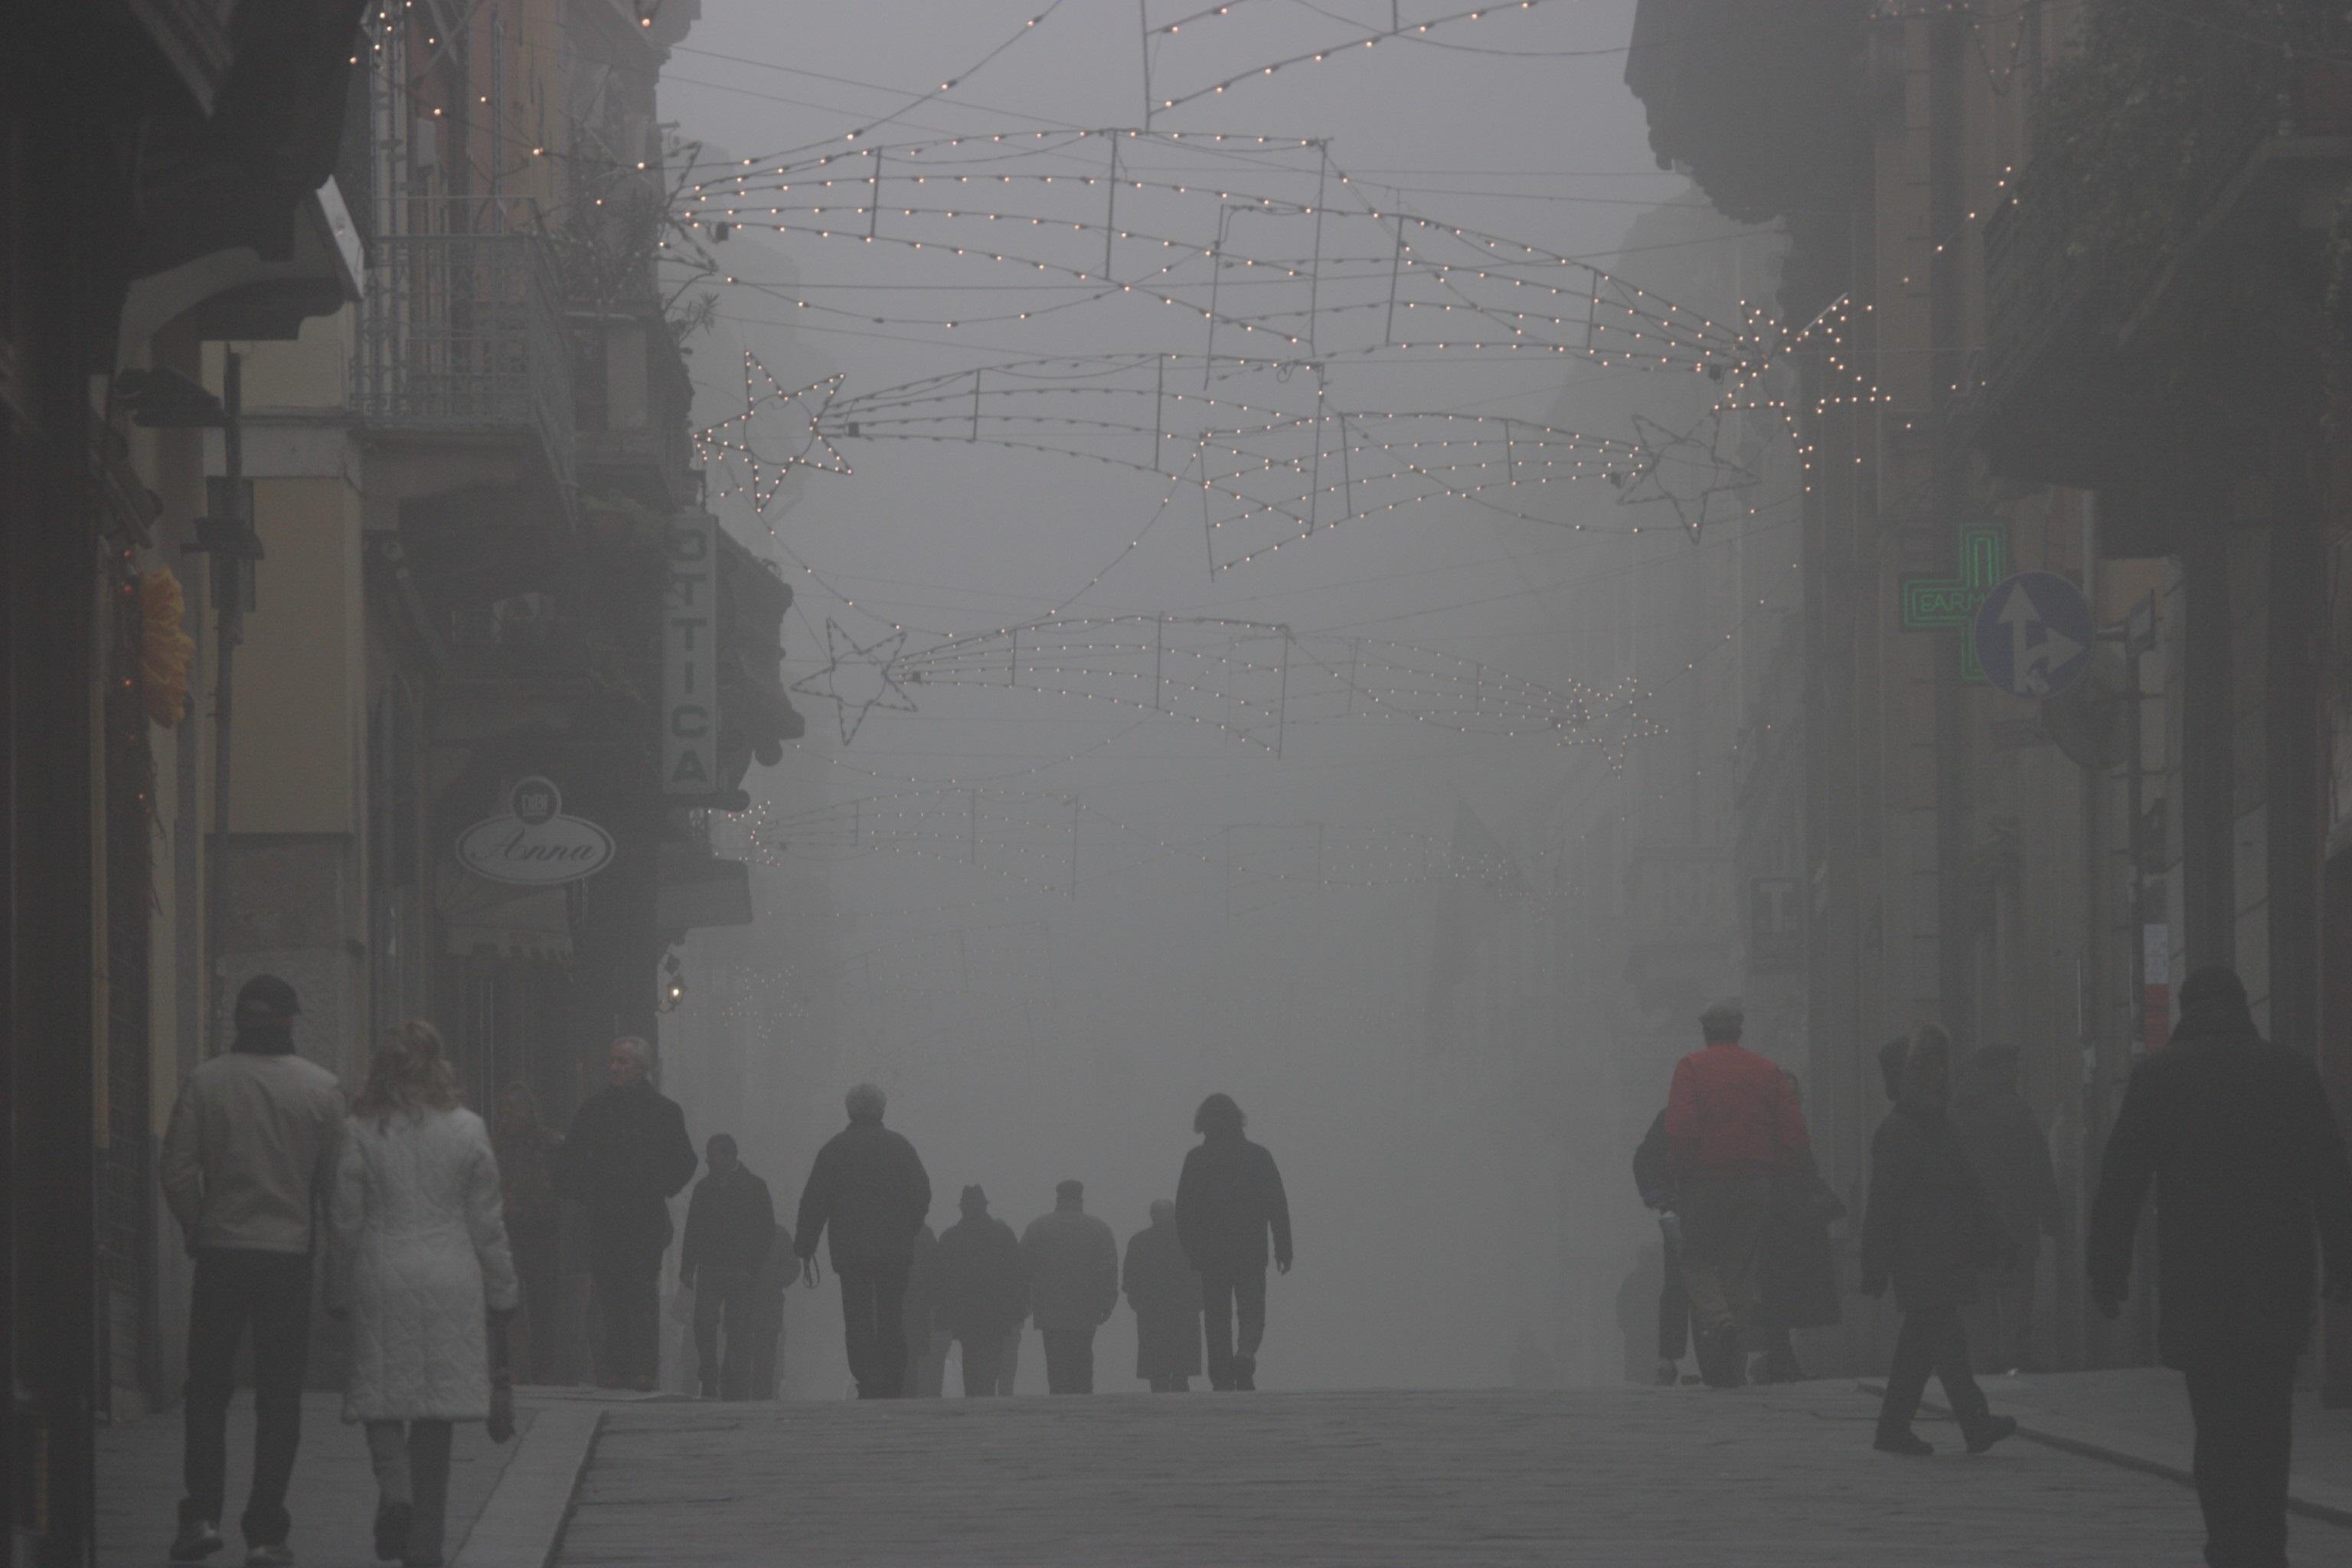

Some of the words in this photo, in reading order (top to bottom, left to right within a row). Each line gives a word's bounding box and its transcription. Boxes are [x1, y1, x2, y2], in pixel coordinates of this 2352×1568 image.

[1920, 592, 1985, 612] FARM
[671, 528, 709, 782] OTTICA
[471, 827, 596, 862] Anna
[1759, 882, 1793, 933] T
